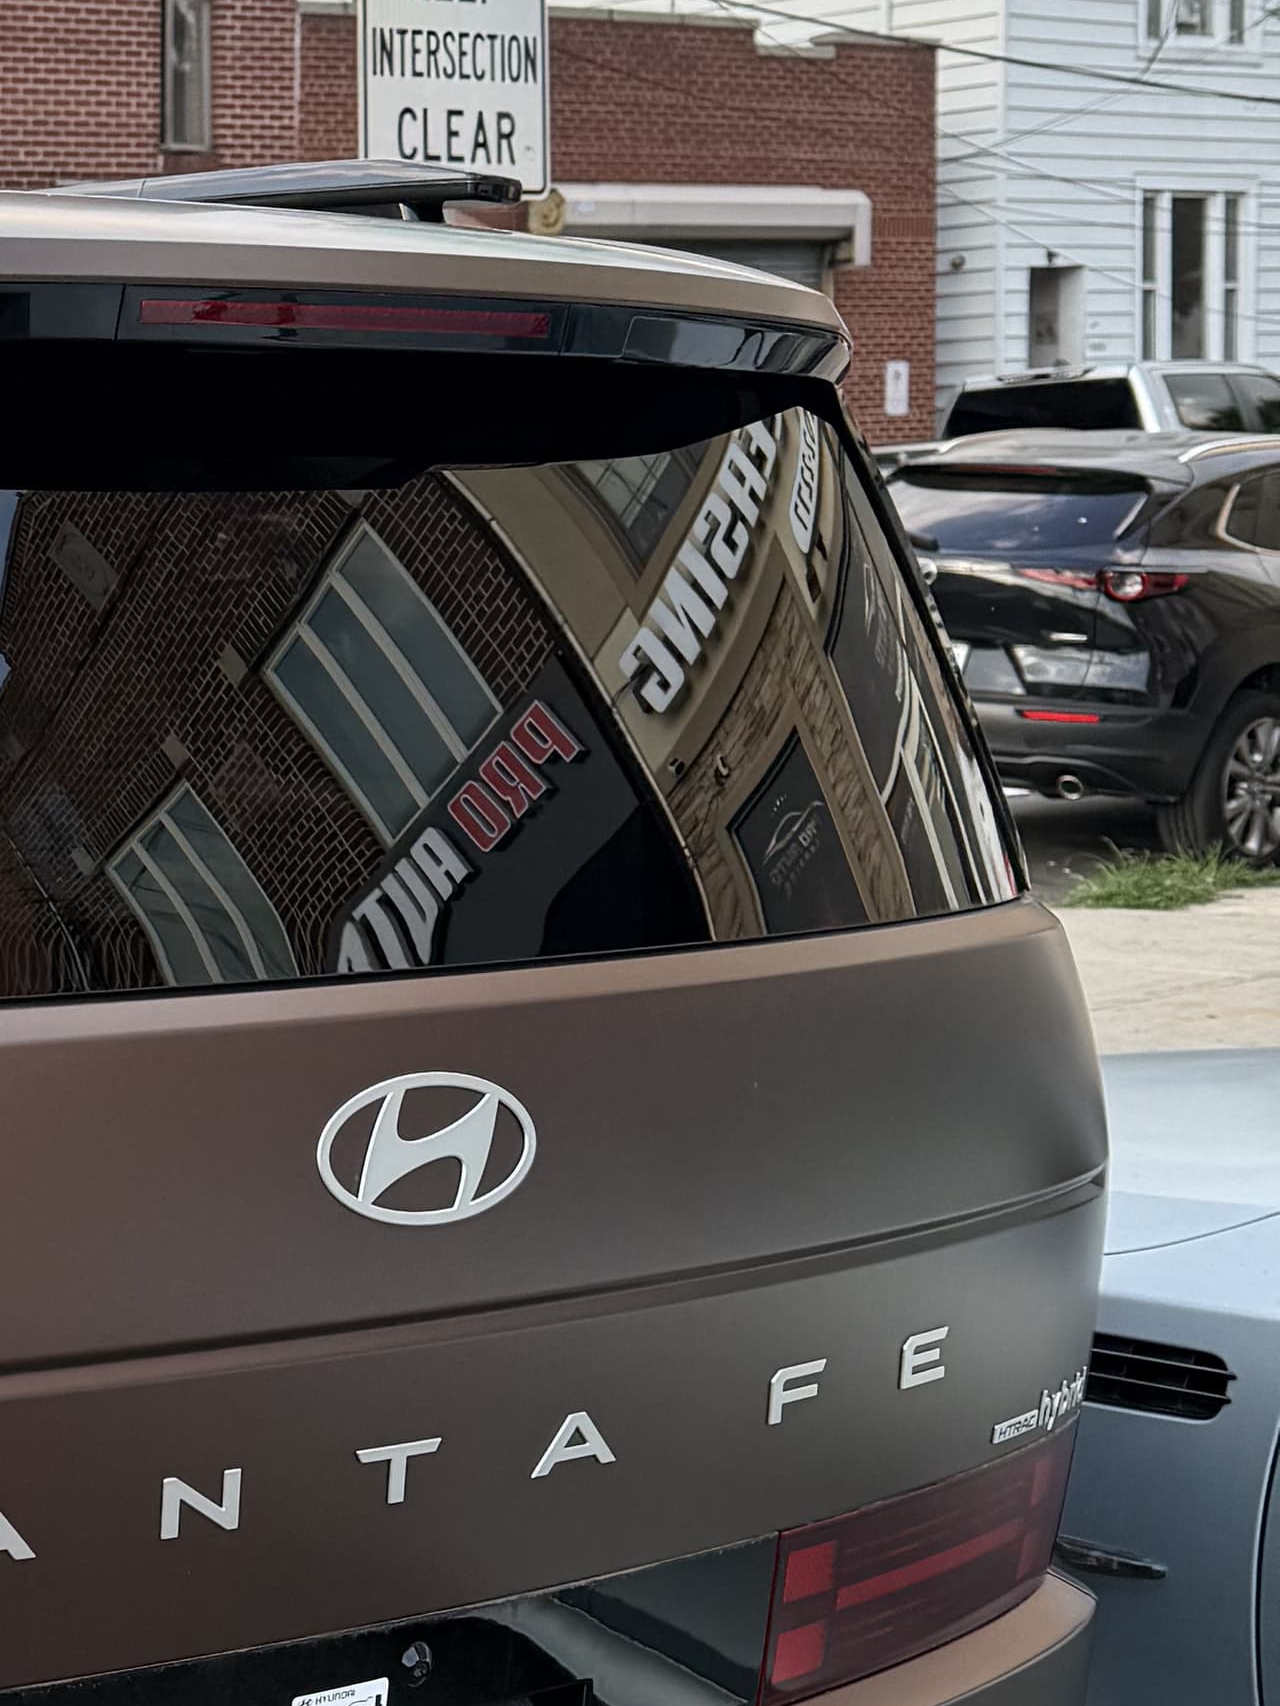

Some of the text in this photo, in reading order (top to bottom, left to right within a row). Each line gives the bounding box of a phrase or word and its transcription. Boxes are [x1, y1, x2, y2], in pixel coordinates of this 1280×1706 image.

[370, 27, 538, 85] INTERSECTION
[396, 107, 517, 166] CLEAR
[767, 1326, 950, 1426] FE
[1039, 1365, 1089, 1431] hybrid
